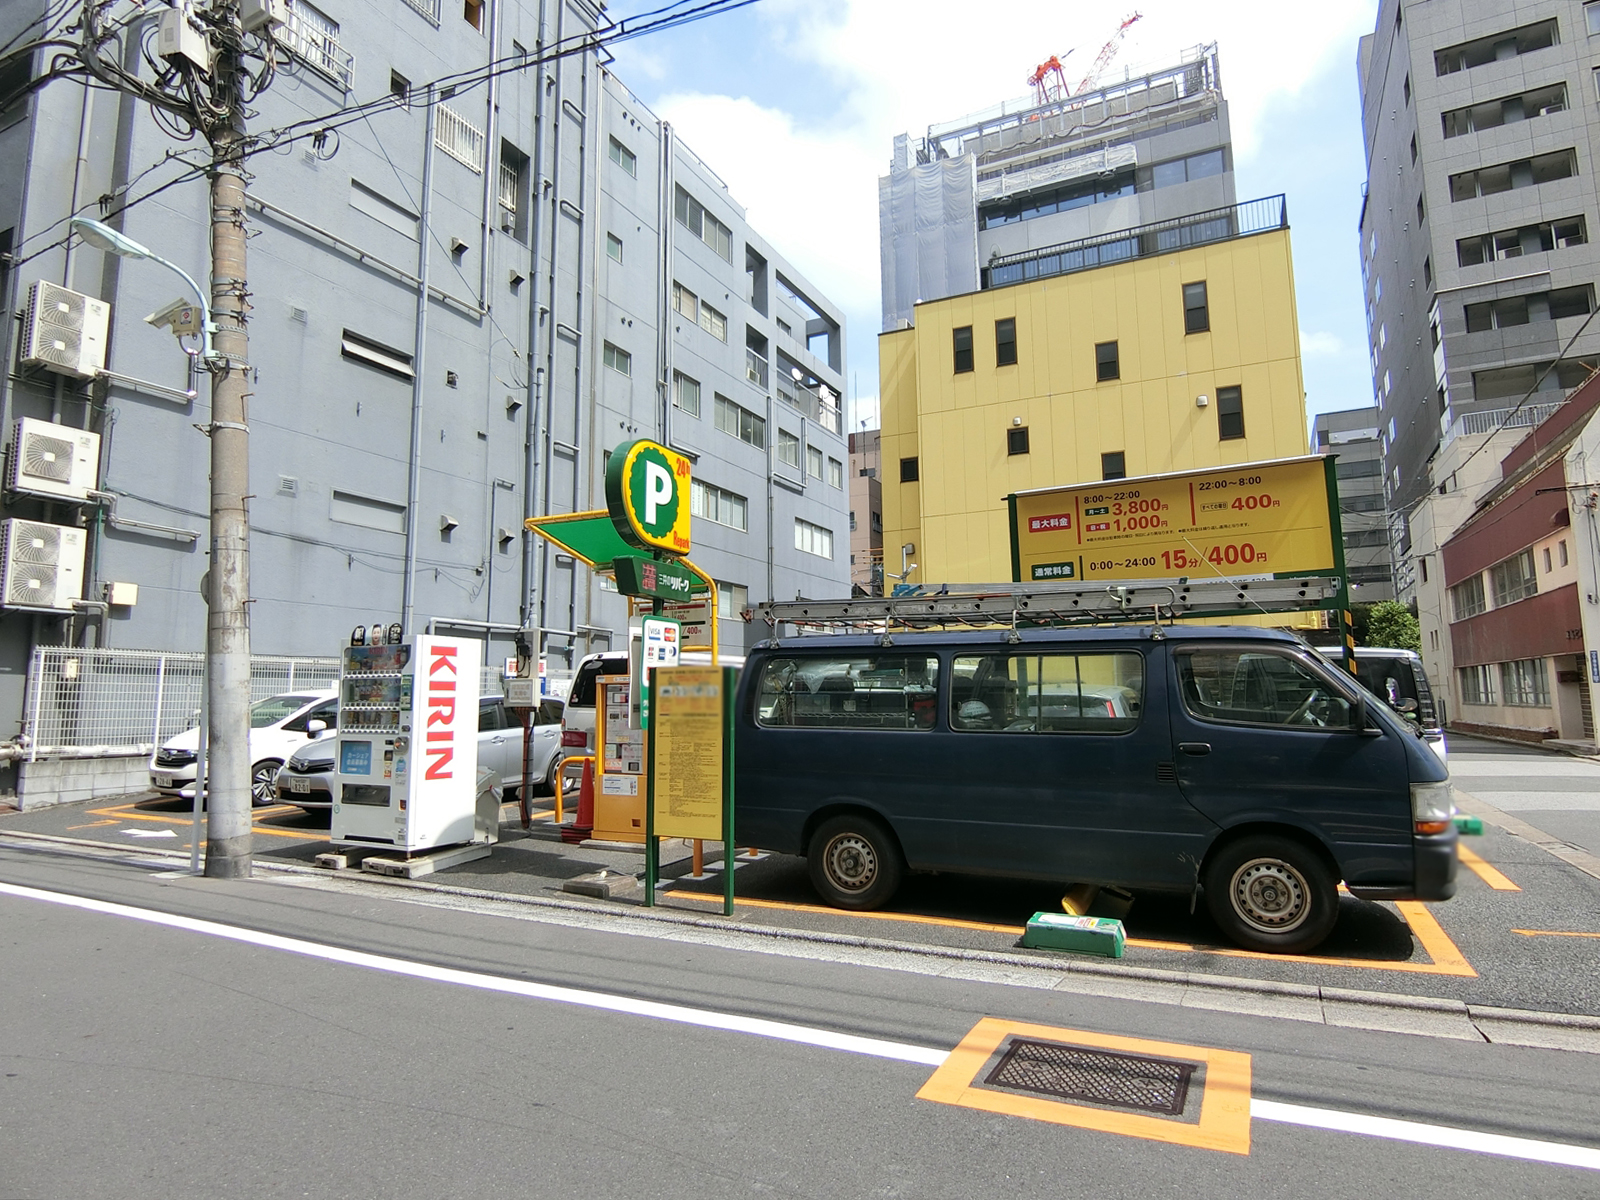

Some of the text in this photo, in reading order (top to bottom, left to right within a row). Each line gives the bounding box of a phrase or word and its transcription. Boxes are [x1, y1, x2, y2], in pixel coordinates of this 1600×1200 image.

[676, 457, 691, 478] 24h
[645, 460, 672, 526] P
[1231, 494, 1280, 510] 400円
[1112, 498, 1168, 516] 3,800円
[1031, 517, 1069, 529] 最大料金
[1113, 515, 1168, 532] 1,000円
[674, 530, 690, 549] Repark
[1034, 565, 1071, 577] 通常料金
[658, 573, 690, 592] 三井のリパーク
[650, 627, 661, 635] VISA
[425, 646, 457, 781] KIRIN
